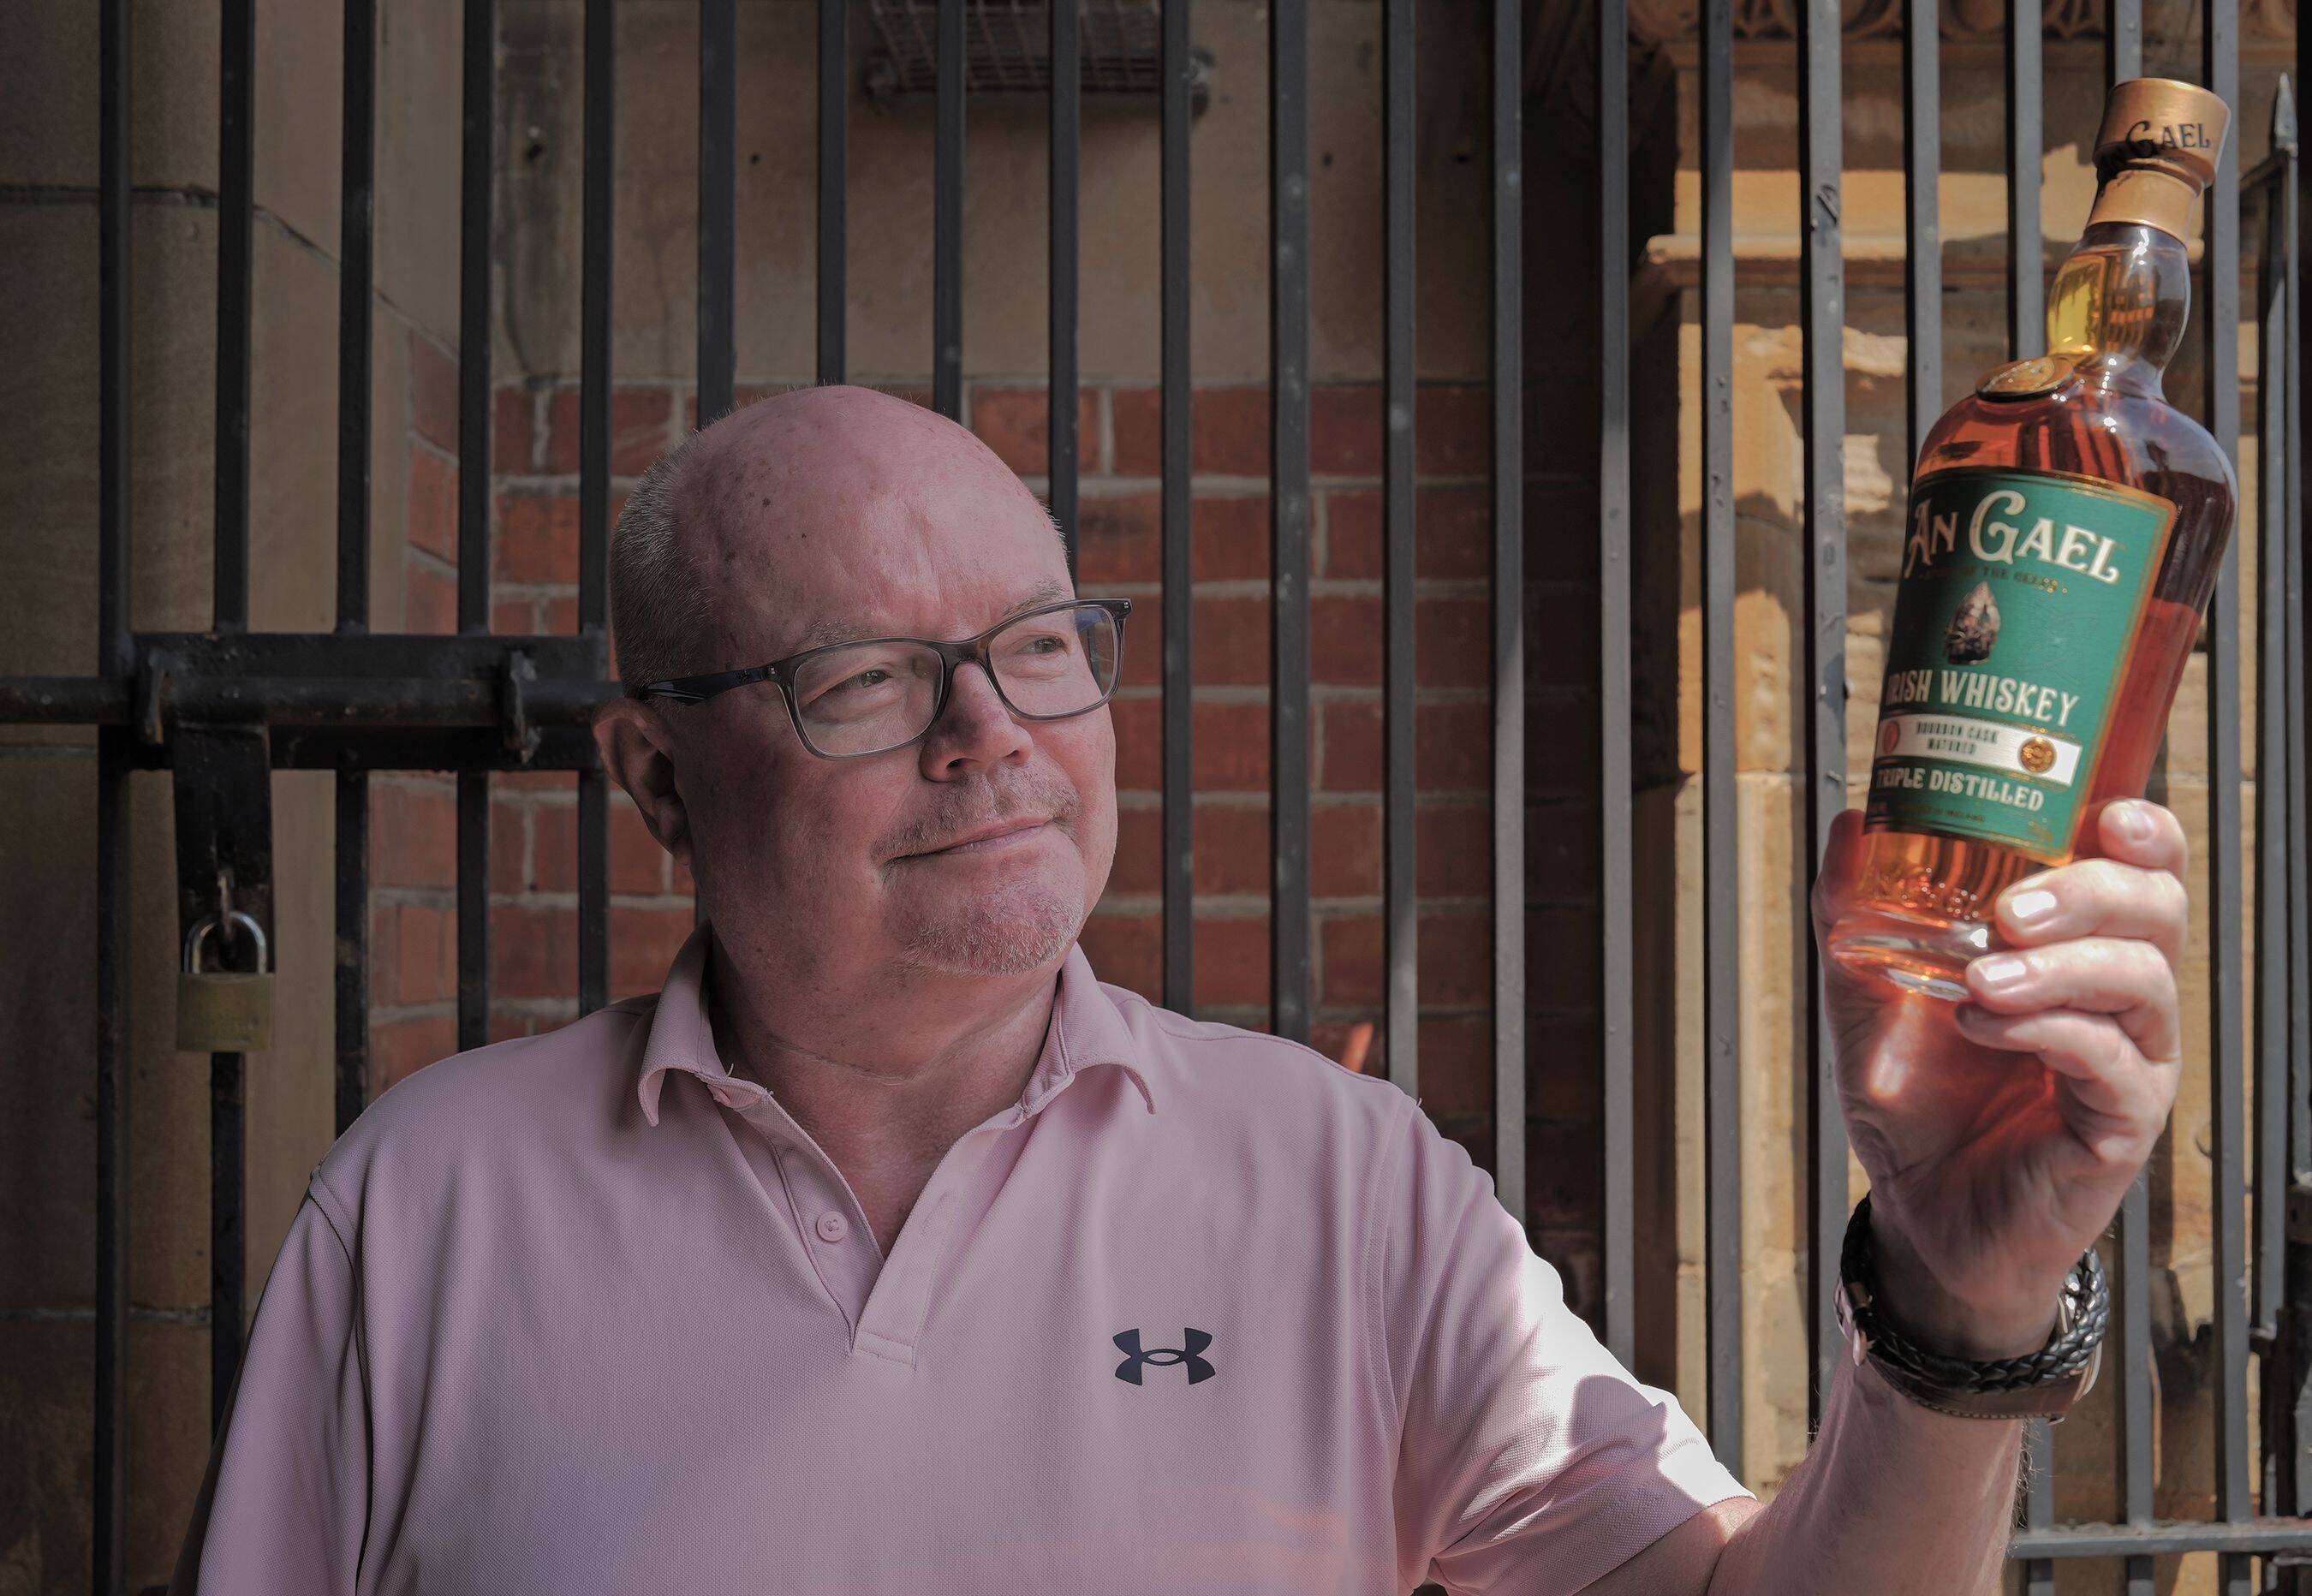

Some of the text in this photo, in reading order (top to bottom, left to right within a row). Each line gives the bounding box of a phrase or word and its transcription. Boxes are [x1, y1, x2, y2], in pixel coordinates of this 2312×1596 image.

[2125, 120, 2211, 158] GAEL
[1904, 490, 2120, 585] AN GAEL
[1940, 670, 2079, 727] WHISKEY
[1916, 721, 1999, 744] BOURBON CASK
[1927, 738, 1977, 755] MATURED
[1876, 767, 2046, 812] TRIPLE DISTILLED
